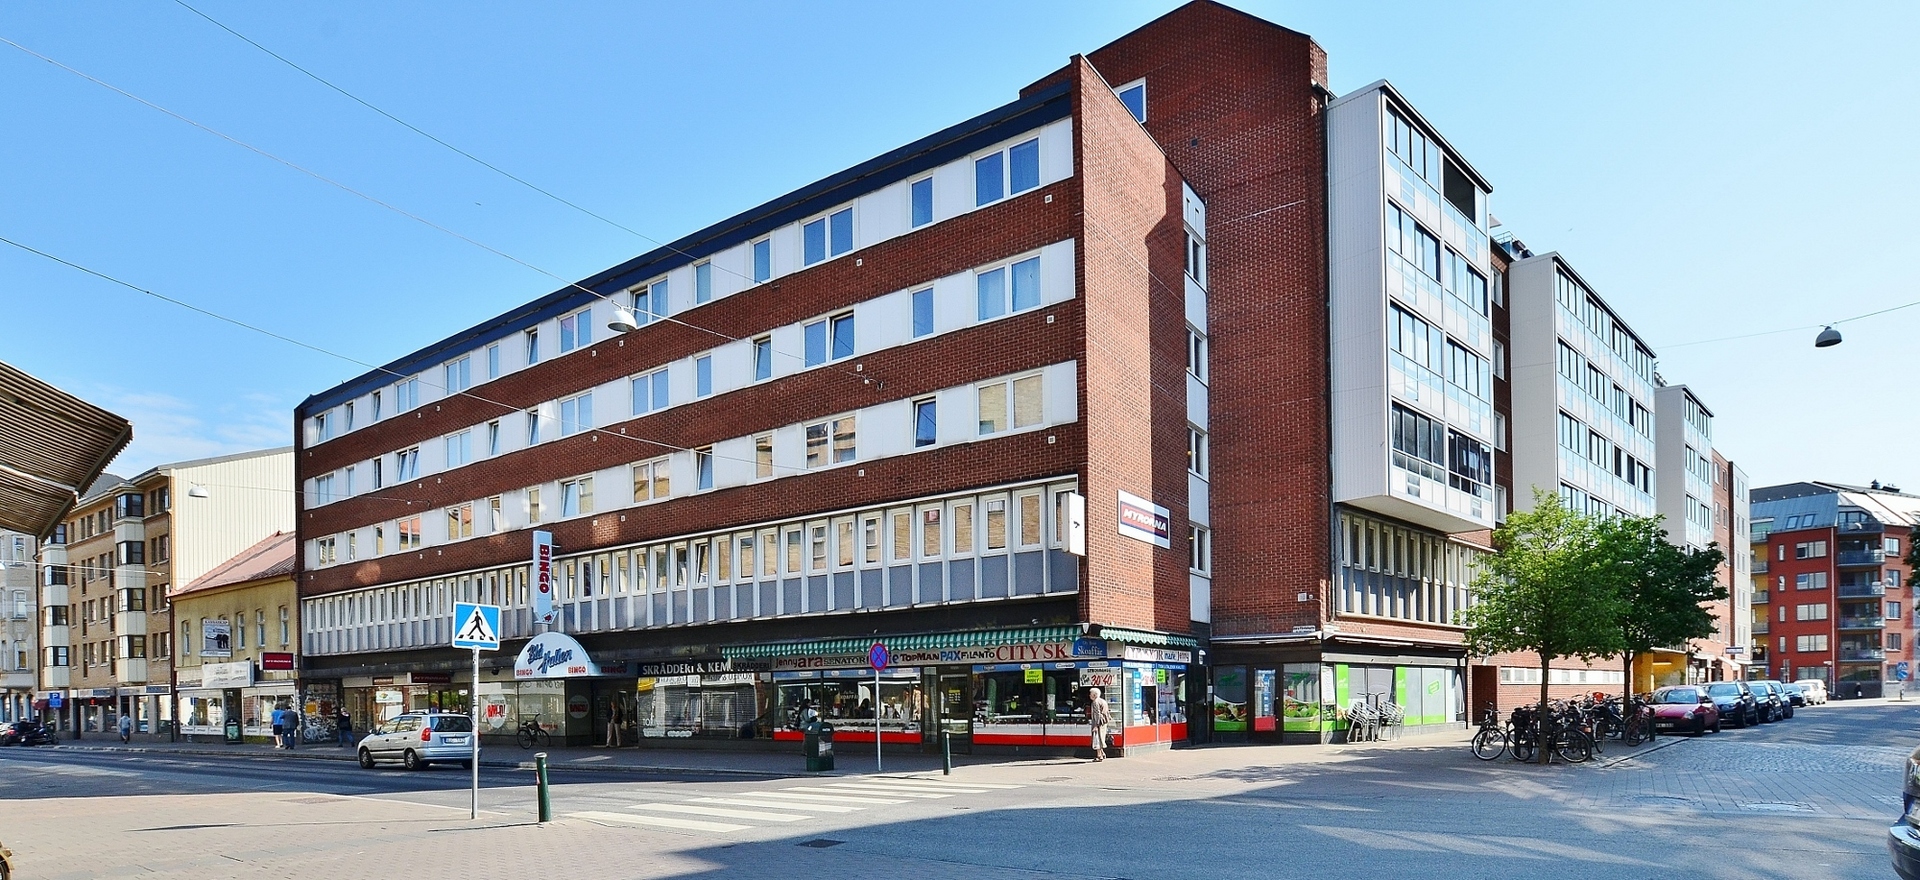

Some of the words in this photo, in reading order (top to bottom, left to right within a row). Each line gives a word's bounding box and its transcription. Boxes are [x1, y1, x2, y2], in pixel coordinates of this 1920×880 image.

[539, 544, 550, 594] BINGO
[537, 648, 573, 674] Hallen
[797, 656, 823, 668] ara
[823, 656, 865, 665] SENATOR
[940, 650, 961, 661] PAX
[567, 665, 586, 674] BINGO
[600, 665, 628, 674] BINGO
[696, 662, 706, 673] &
